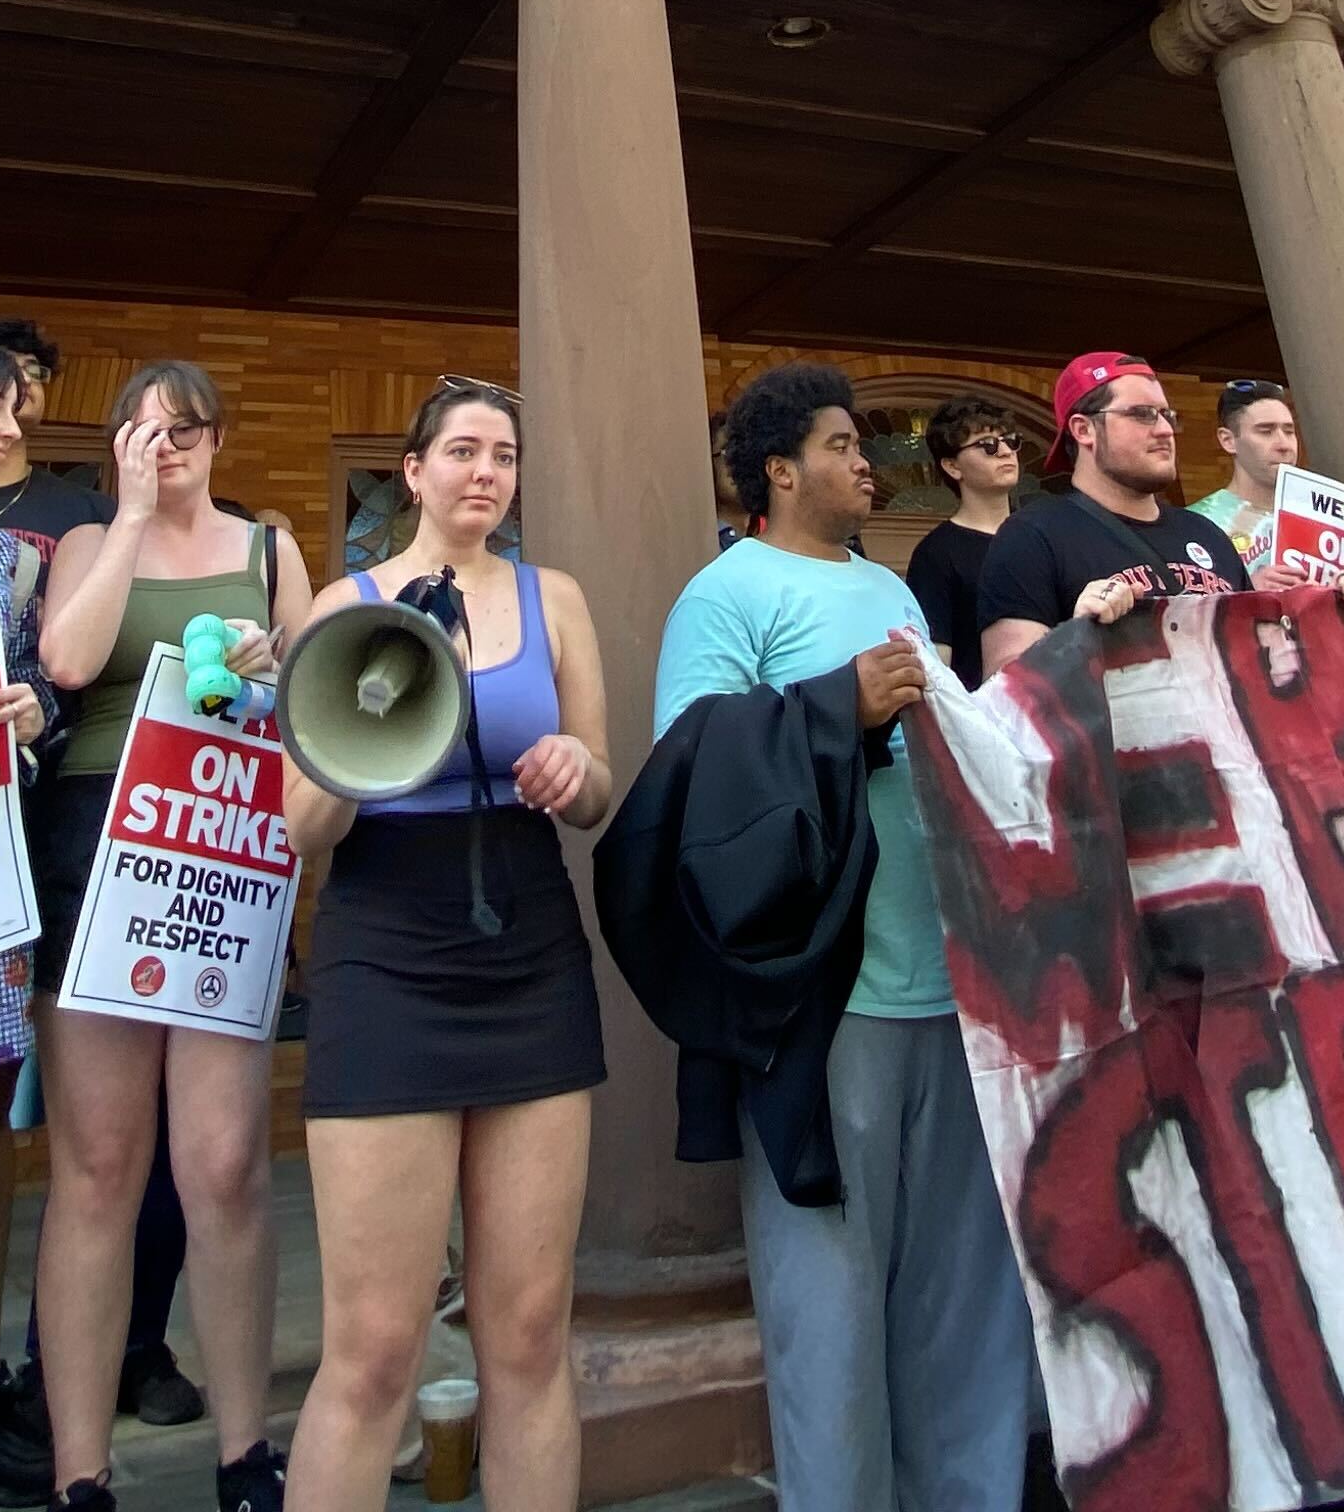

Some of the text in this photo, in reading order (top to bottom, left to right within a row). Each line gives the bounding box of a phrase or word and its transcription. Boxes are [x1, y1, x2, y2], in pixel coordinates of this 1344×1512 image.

[1311, 491, 1344, 520] WE
[1282, 548, 1340, 586] STR
[191, 744, 260, 804] ON
[122, 782, 290, 867] STRIKE
[115, 851, 282, 910] FOR DIGNITY
[165, 893, 225, 928] AND
[126, 915, 250, 964] RESPECT
